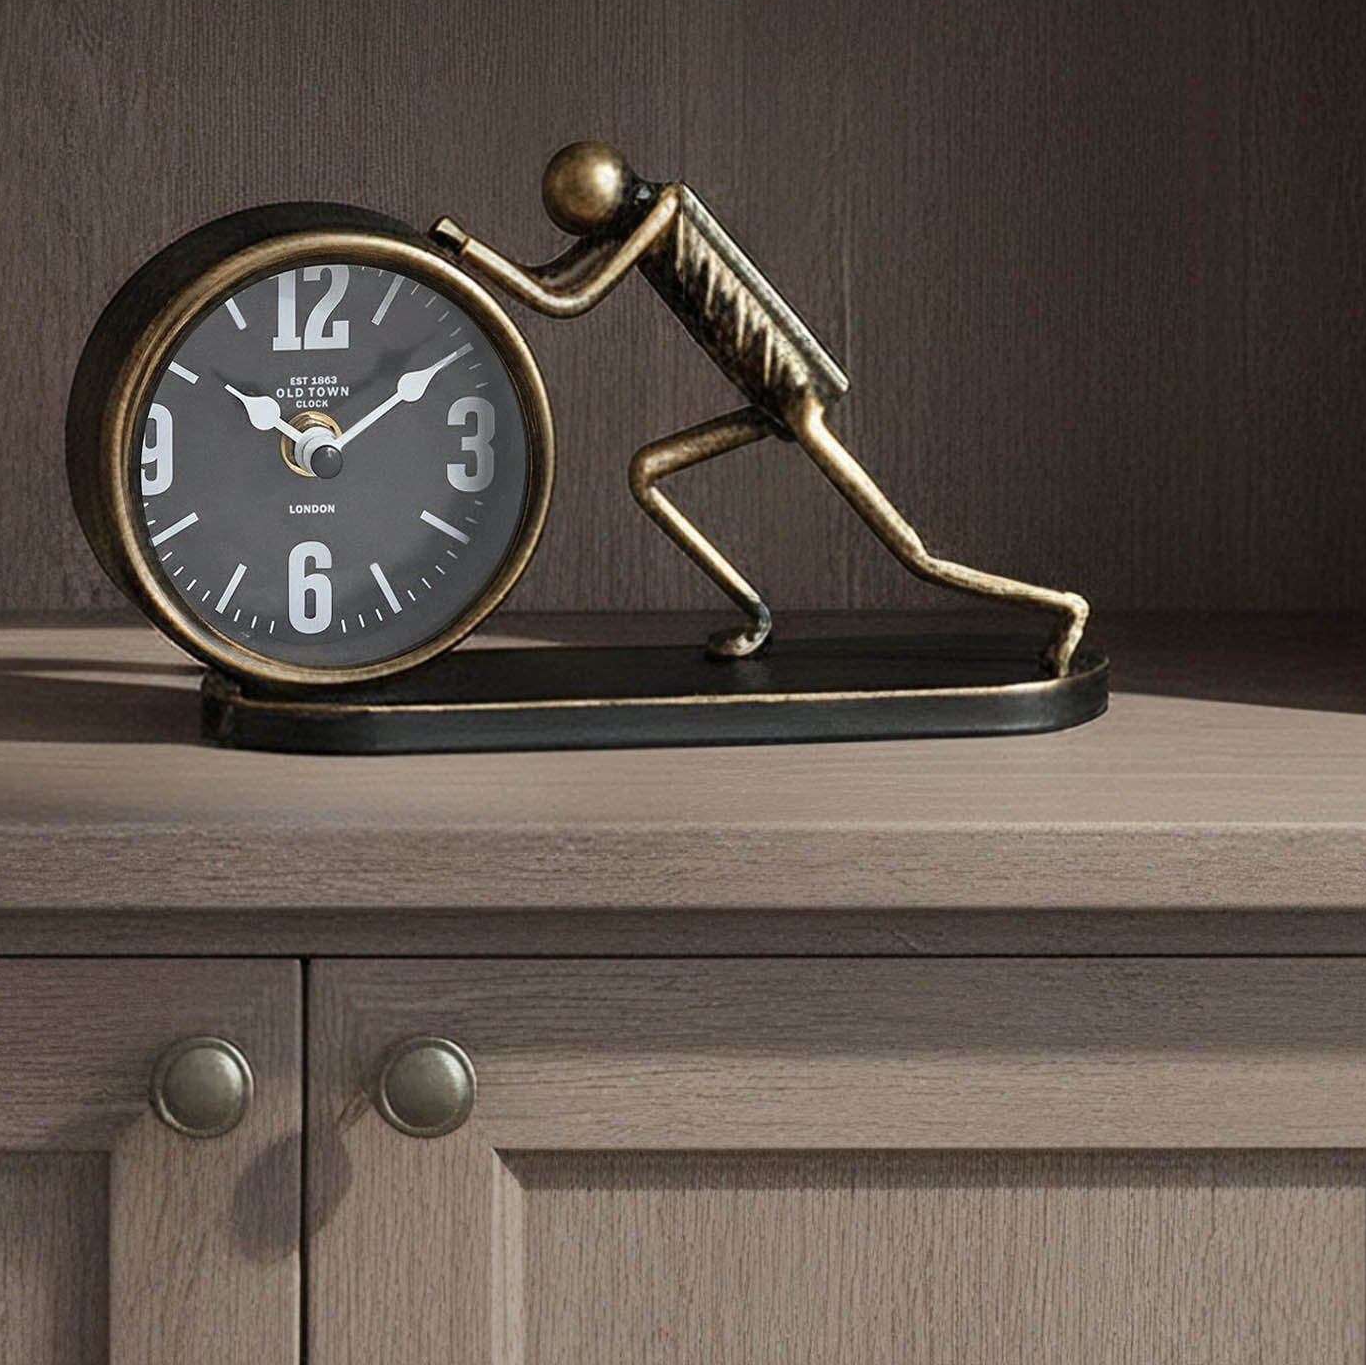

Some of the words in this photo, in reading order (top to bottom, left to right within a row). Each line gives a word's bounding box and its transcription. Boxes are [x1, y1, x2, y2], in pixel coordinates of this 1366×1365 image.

[270, 264, 350, 351] 12
[276, 388, 304, 398] OLD
[308, 386, 349, 397] TOWN
[290, 376, 308, 385] EST
[311, 376, 337, 385] 1863
[296, 399, 328, 408] CLOCK
[140, 402, 173, 496] 9
[446, 396, 496, 492] 3
[288, 503, 336, 514] LONDON
[288, 540, 333, 635] 6
